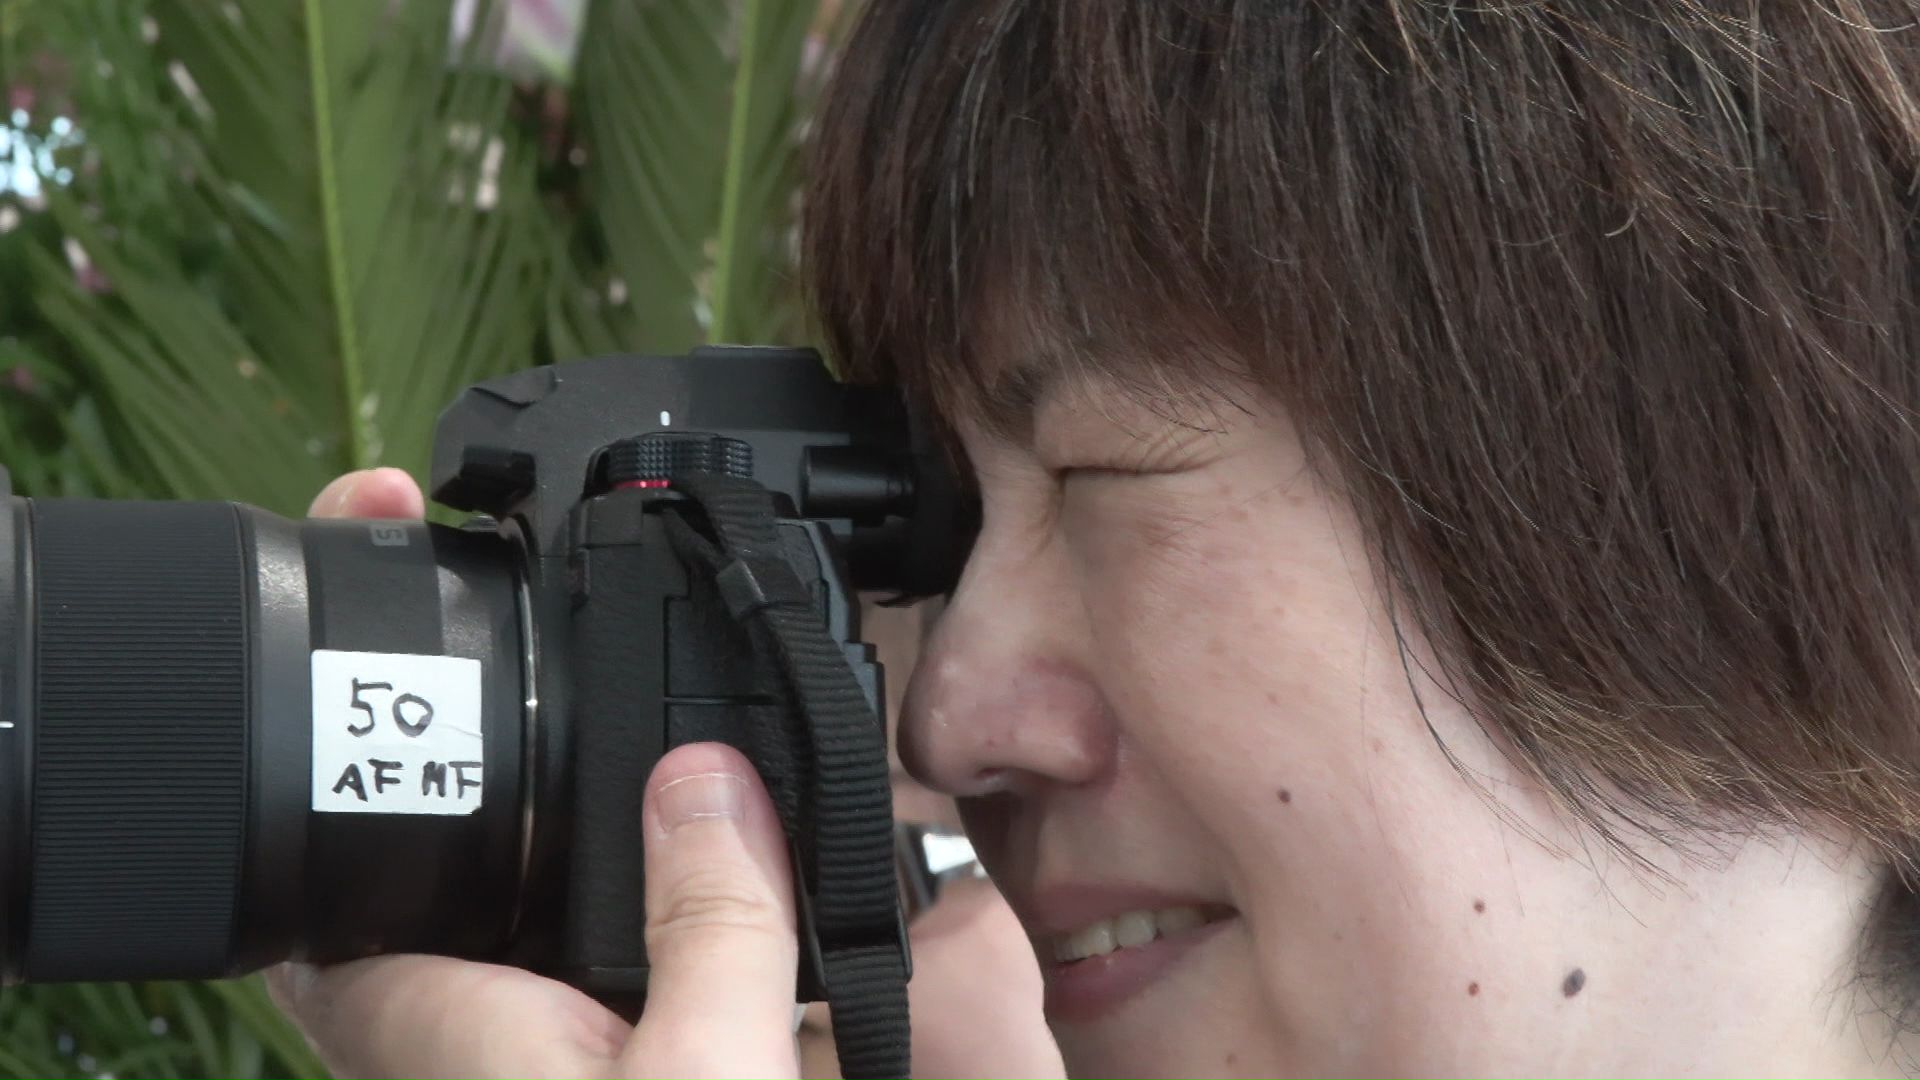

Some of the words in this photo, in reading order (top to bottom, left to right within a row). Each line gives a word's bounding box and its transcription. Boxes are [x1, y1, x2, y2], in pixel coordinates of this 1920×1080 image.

[346, 677, 434, 738] 50
[331, 757, 404, 802] AF
[421, 760, 483, 800] MF
